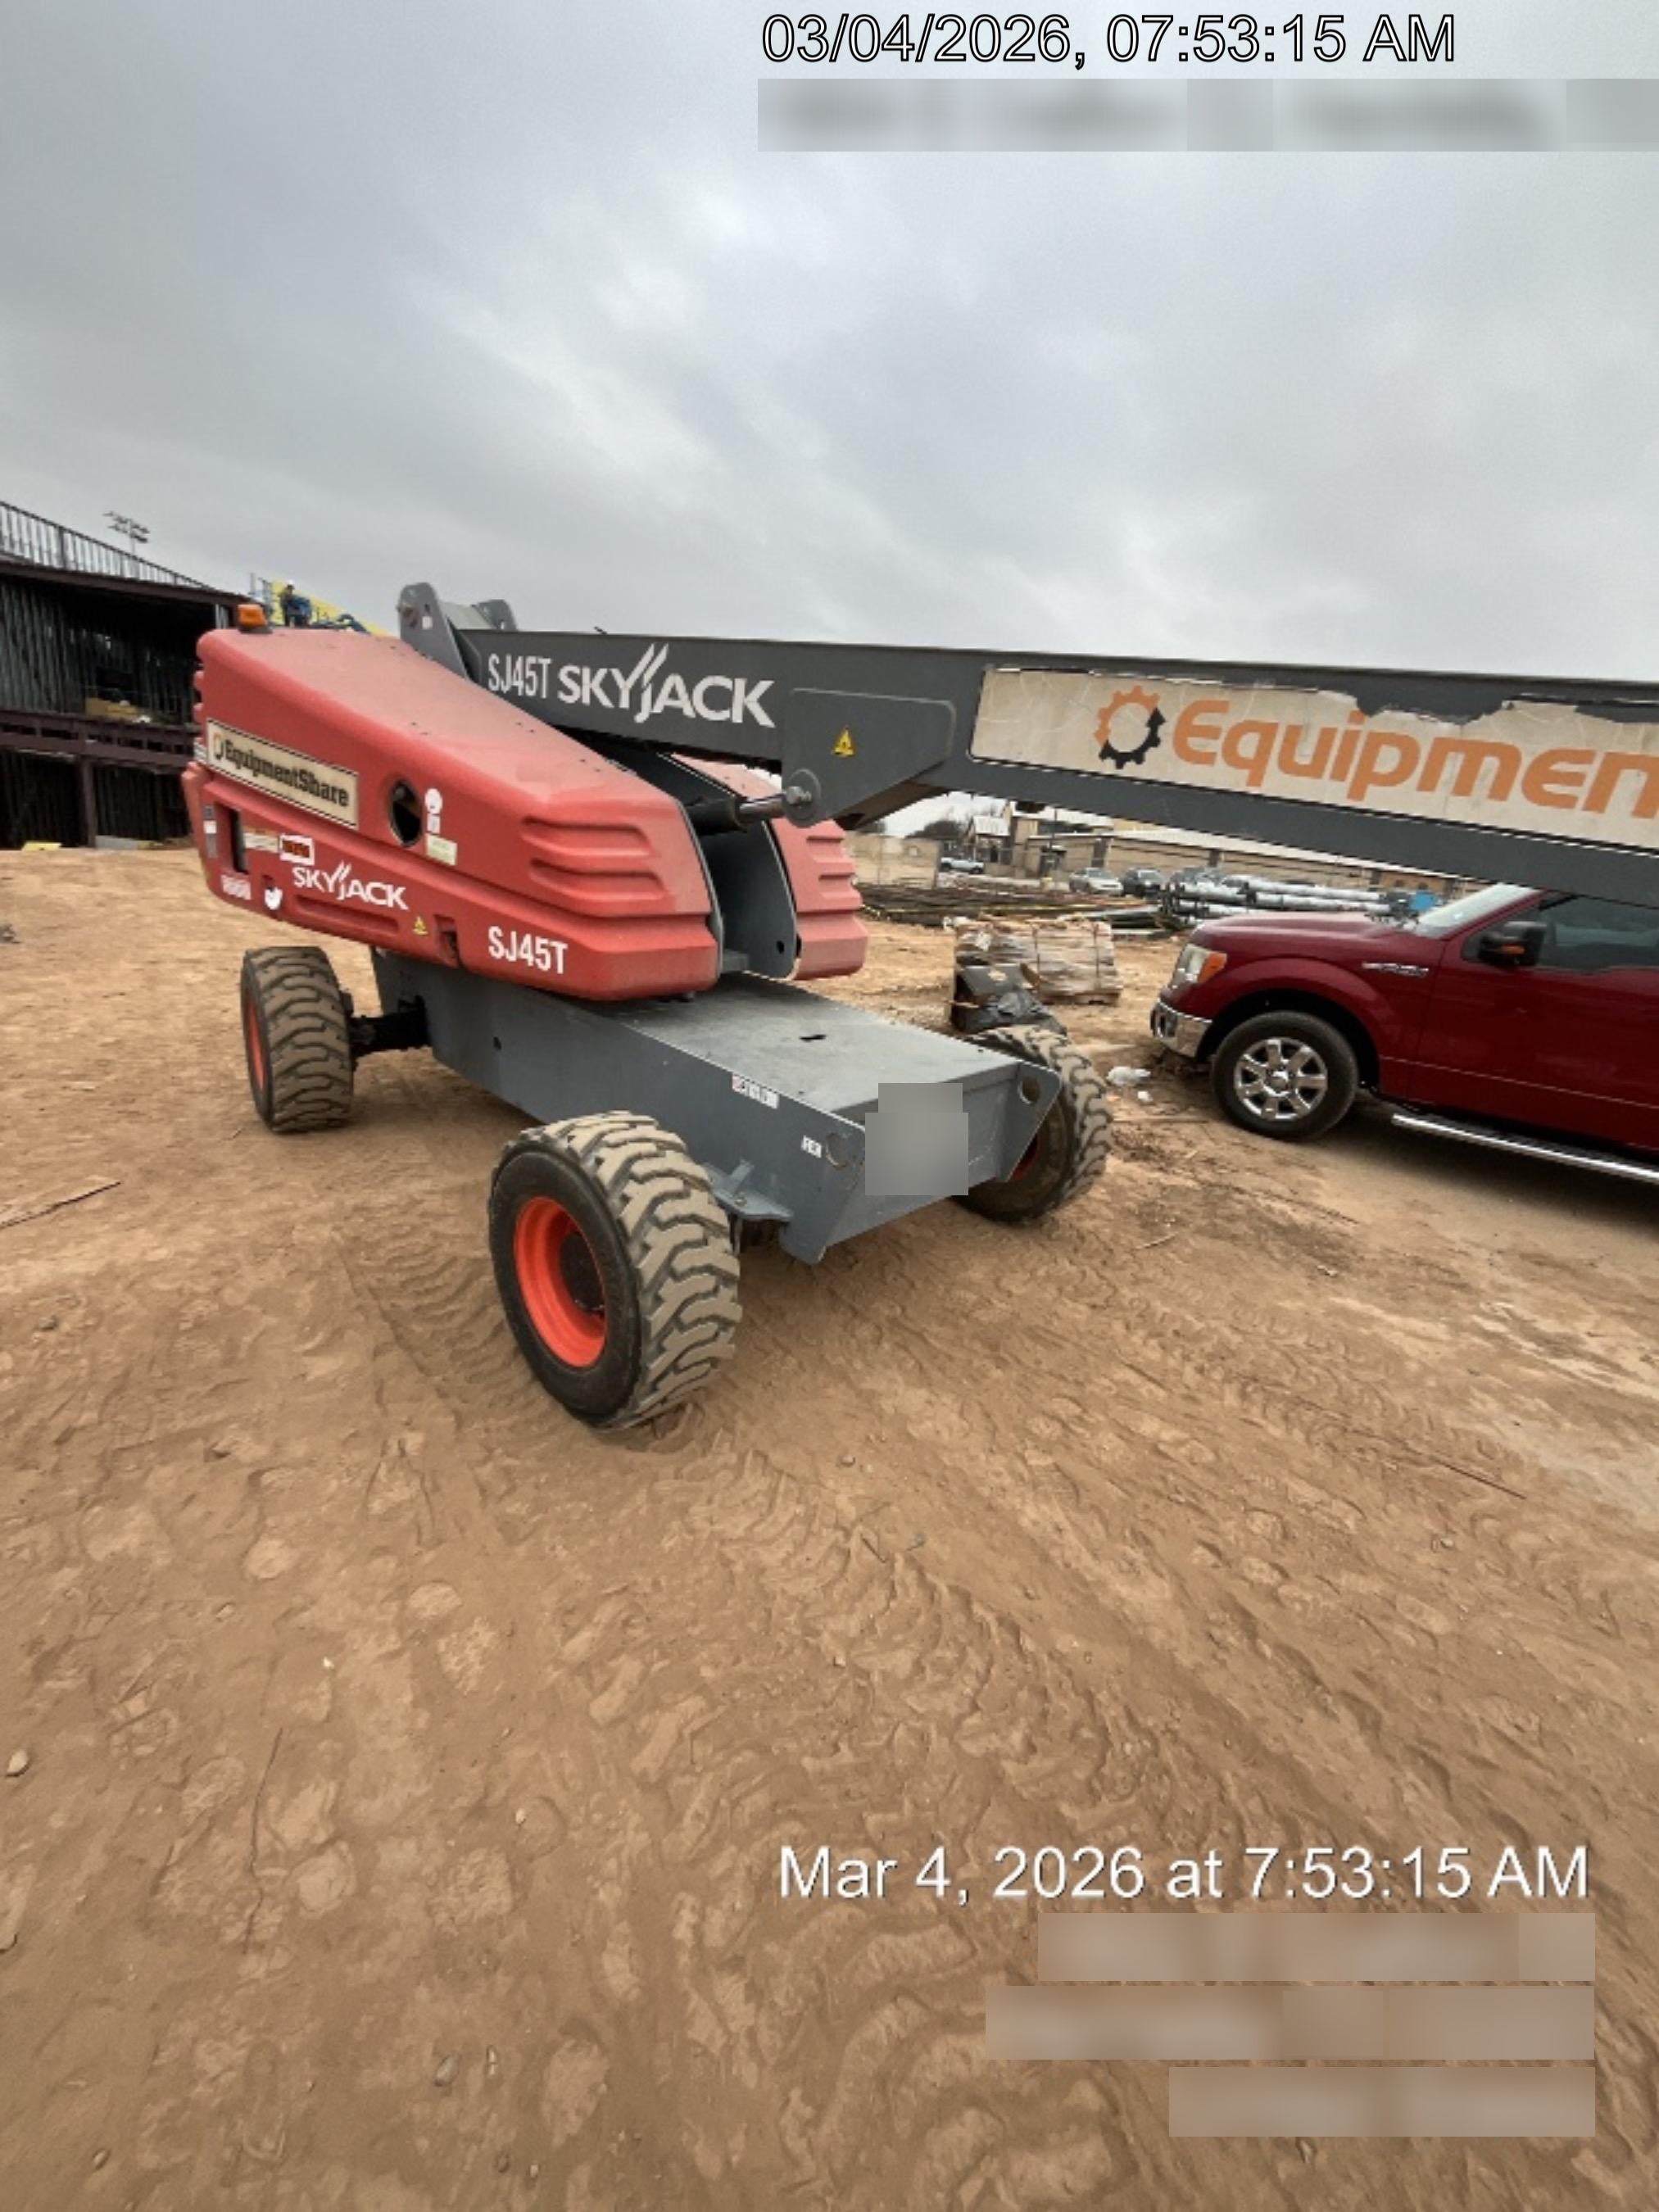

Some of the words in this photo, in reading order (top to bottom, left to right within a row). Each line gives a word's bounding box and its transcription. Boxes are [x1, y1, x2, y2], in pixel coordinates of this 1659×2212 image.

[487, 652, 552, 700] SJ45T
[557, 641, 777, 728] SKYJACK
[224, 738, 350, 807] EquipmentShare
[291, 859, 409, 911] SKYJACK
[487, 925, 569, 975] SJ45T
